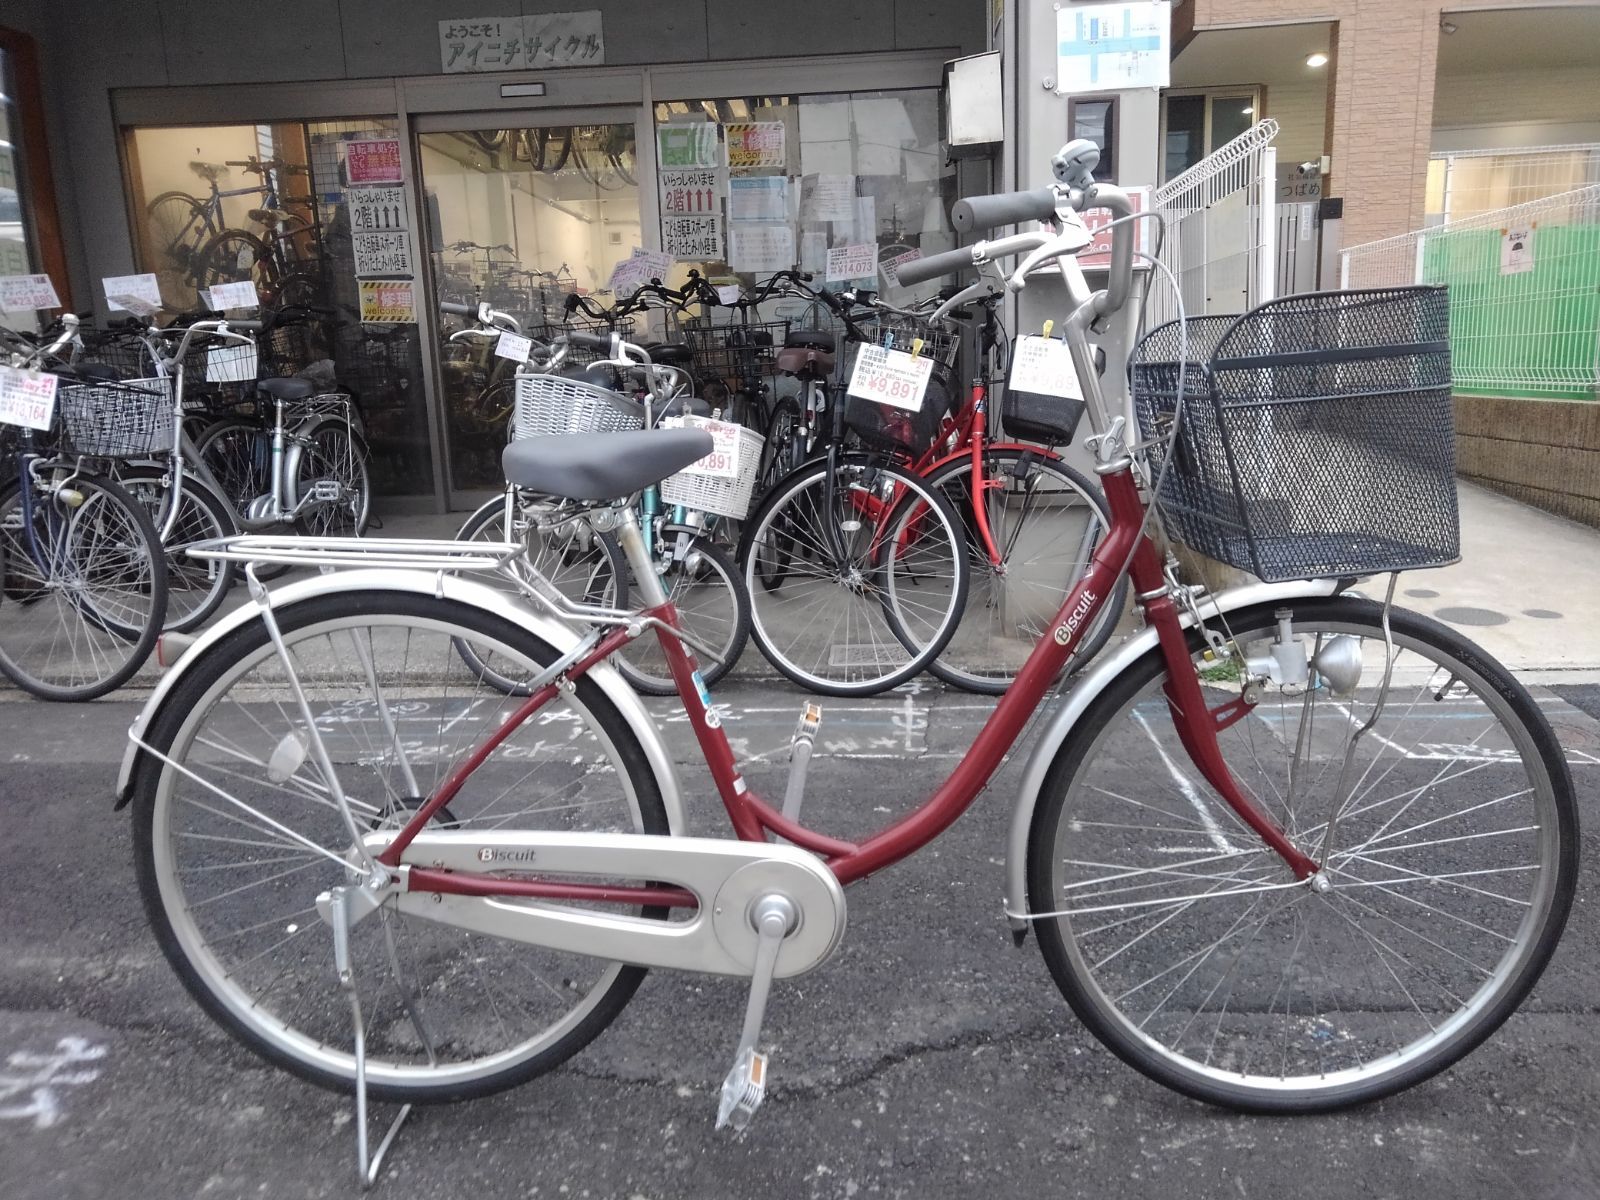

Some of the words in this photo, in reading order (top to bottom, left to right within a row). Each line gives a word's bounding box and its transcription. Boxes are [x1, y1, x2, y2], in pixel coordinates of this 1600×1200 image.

[445, 24, 500, 39] ようこそ!
[447, 33, 600, 67] アイニチサイクル
[663, 172, 715, 186] いらっしゃいませ
[351, 189, 400, 203] いらっしゃいませ
[1281, 183, 1320, 196] つばめ
[868, 375, 919, 401] ¥9,891
[1054, 590, 1096, 646] Biscuit
[478, 847, 536, 863] Biscuit
